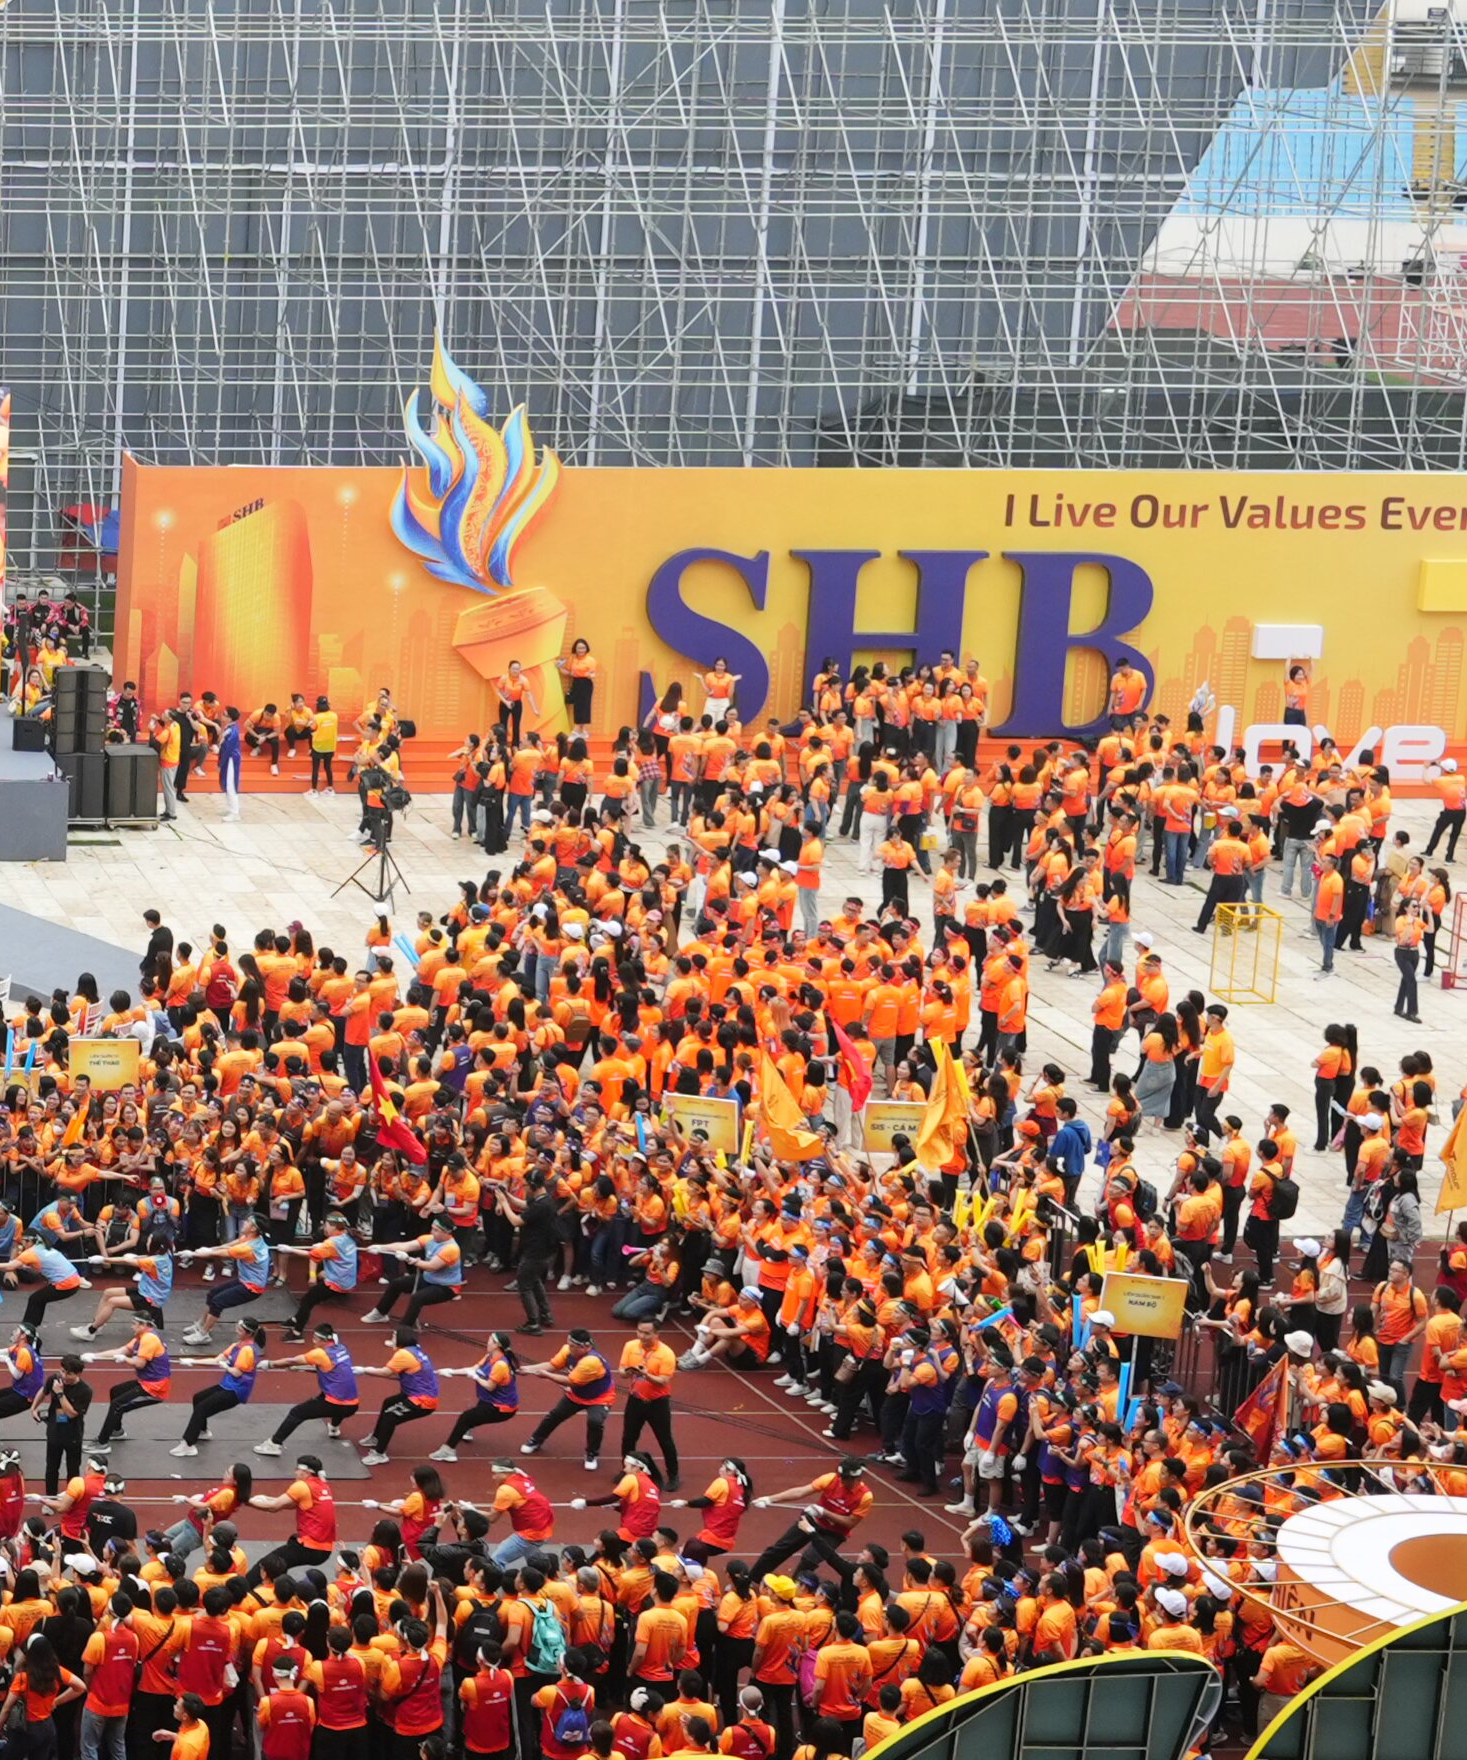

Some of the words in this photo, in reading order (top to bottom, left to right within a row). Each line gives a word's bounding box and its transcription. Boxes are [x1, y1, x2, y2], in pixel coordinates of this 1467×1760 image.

[233, 497, 264, 523] SHB
[1004, 494, 1015, 527] I
[1028, 493, 1117, 528] Live
[1130, 494, 1209, 529] Our
[1219, 495, 1366, 530] Values
[639, 547, 1156, 740] SHB
